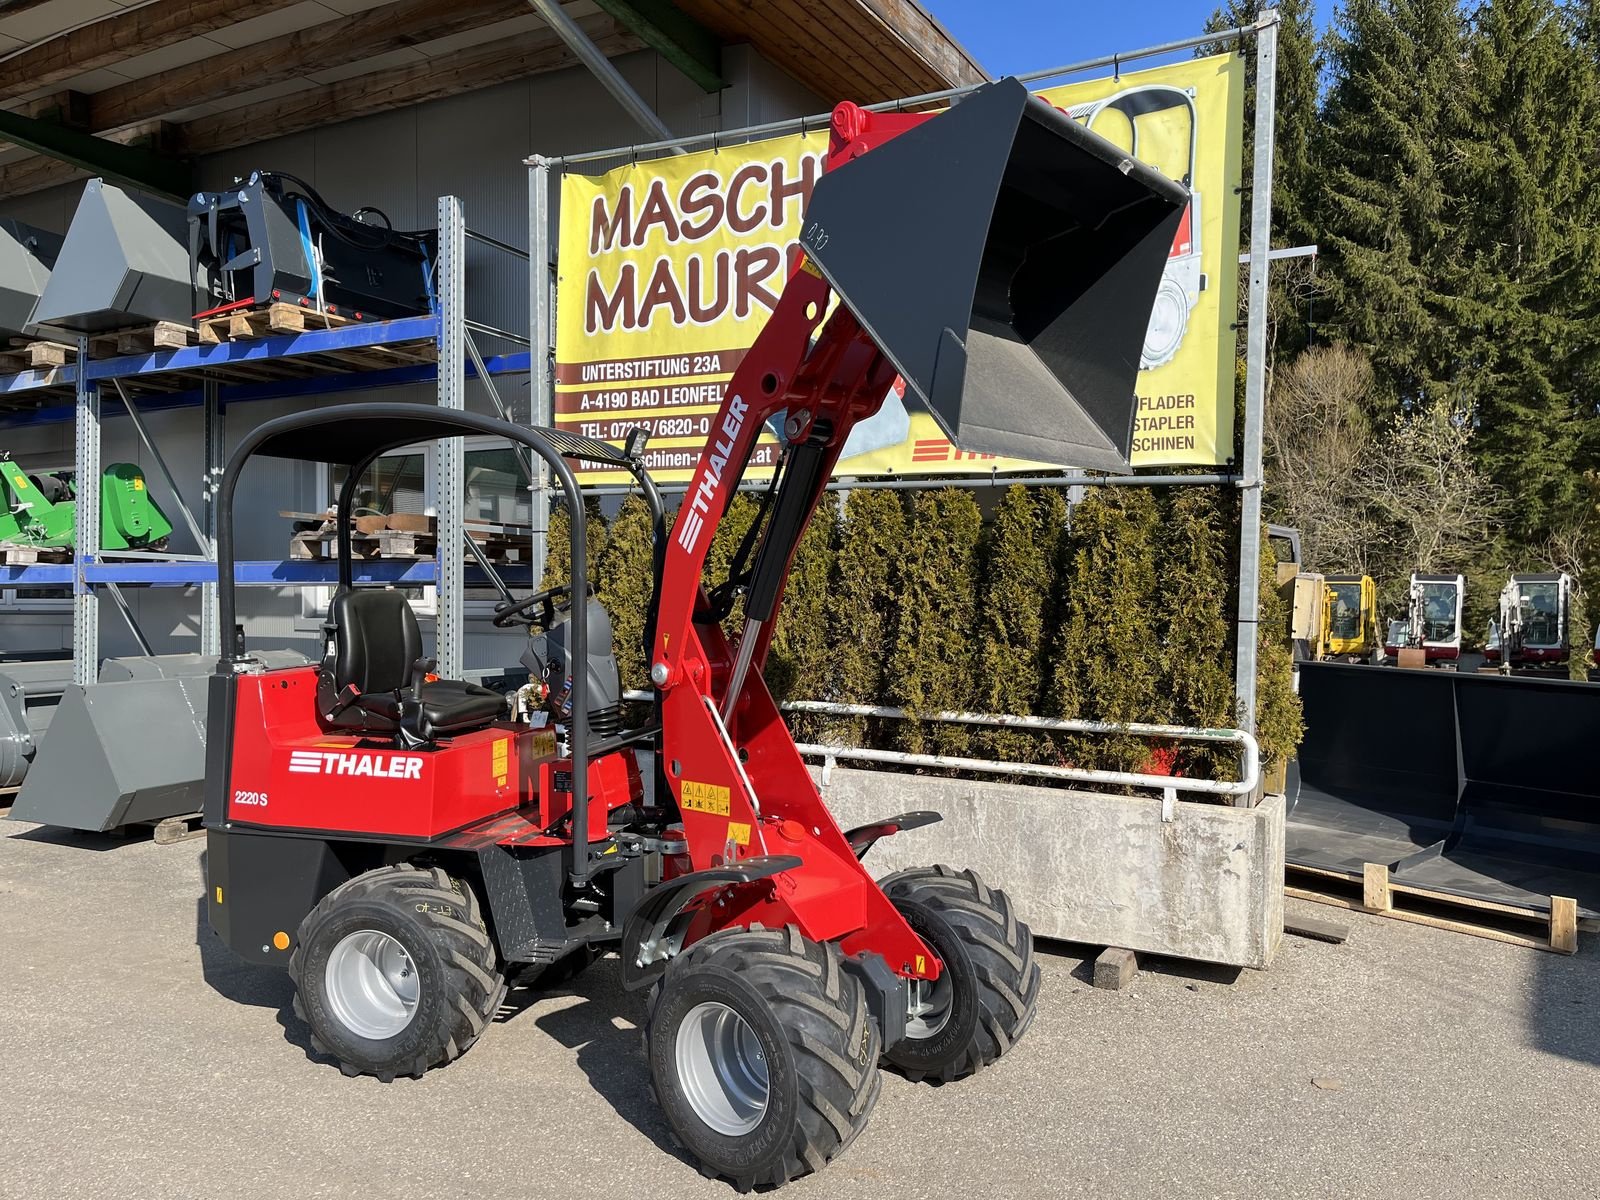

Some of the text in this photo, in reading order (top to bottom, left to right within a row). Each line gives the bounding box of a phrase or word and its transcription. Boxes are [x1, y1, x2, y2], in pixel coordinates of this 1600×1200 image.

[590, 153, 828, 255] MASCH
[582, 354, 721, 382] UNTERSTIFTUNG 23A
[580, 391, 628, 410] A-4190
[631, 389, 660, 407] BAD
[580, 422, 608, 439] TEL:
[691, 394, 750, 514] THALER
[322, 752, 424, 780] THALER
[234, 791, 268, 806] 2220 S
